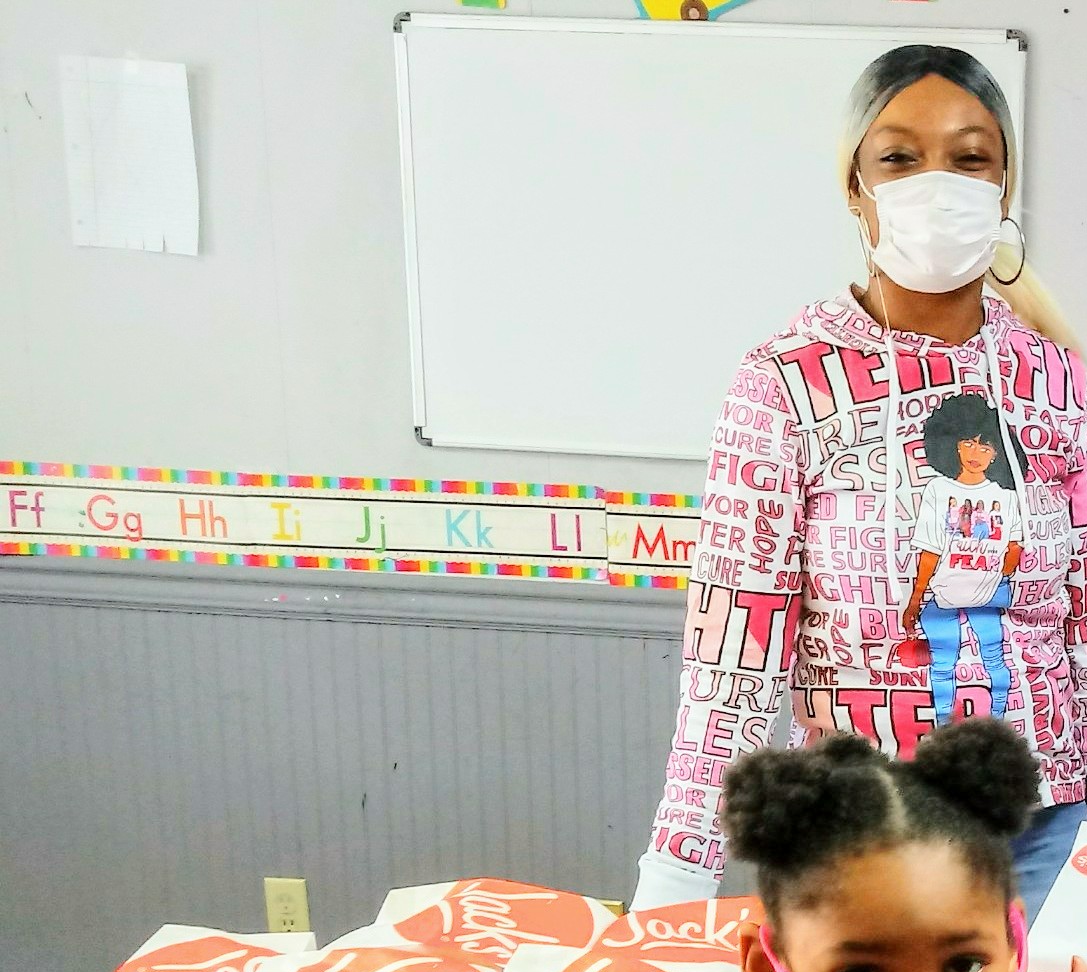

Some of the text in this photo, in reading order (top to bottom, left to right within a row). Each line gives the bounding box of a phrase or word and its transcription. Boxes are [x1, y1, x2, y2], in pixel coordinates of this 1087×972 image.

[8, 490, 45, 528] Ff
[86, 494, 143, 542] Gg
[178, 498, 228, 538] Hh
[270, 501, 302, 541] Ii
[355, 506, 387, 554] Jj
[445, 508, 495, 548] Kk
[549, 512, 582, 552] Ll
